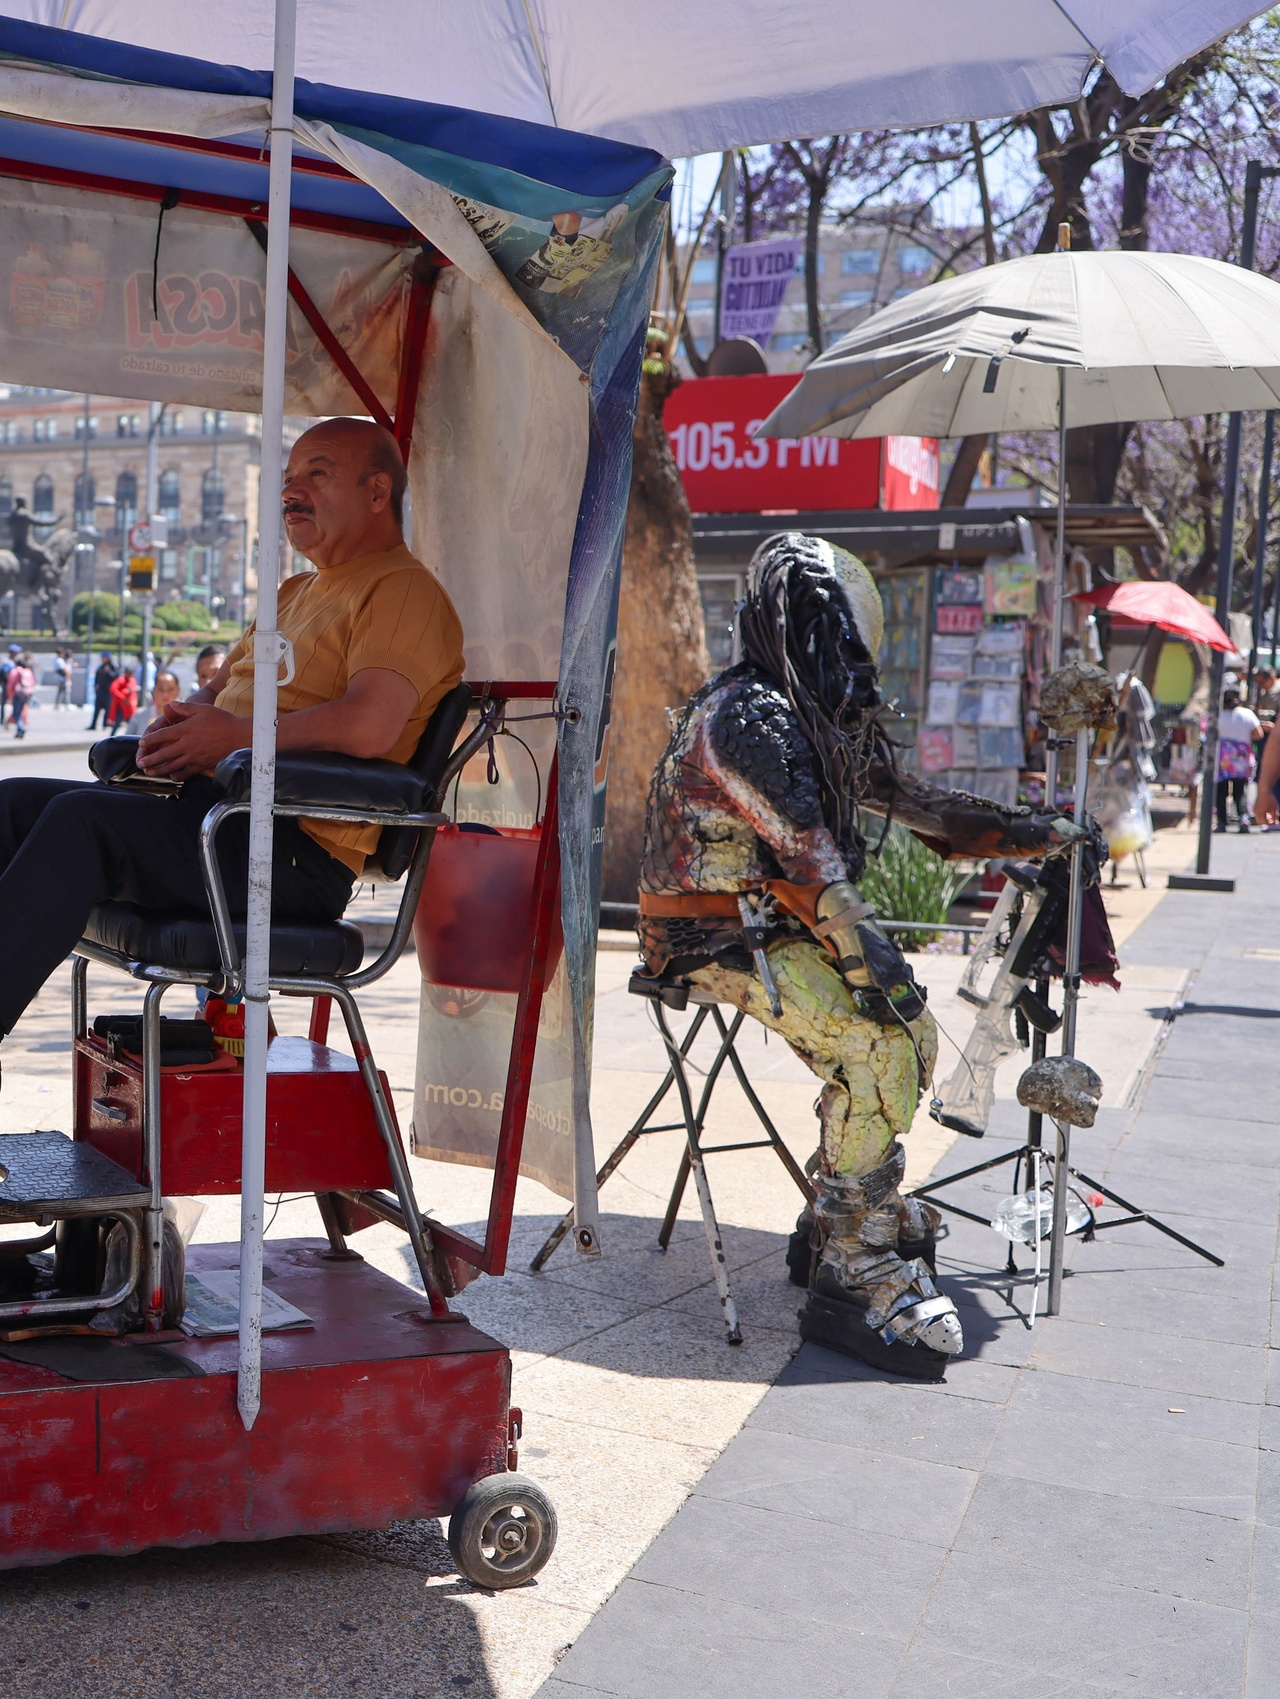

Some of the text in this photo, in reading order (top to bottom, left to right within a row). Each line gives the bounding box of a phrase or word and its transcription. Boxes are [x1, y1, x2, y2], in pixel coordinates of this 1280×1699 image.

[730, 251, 795, 278] TU VIDA
[669, 419, 770, 472] 105.3
